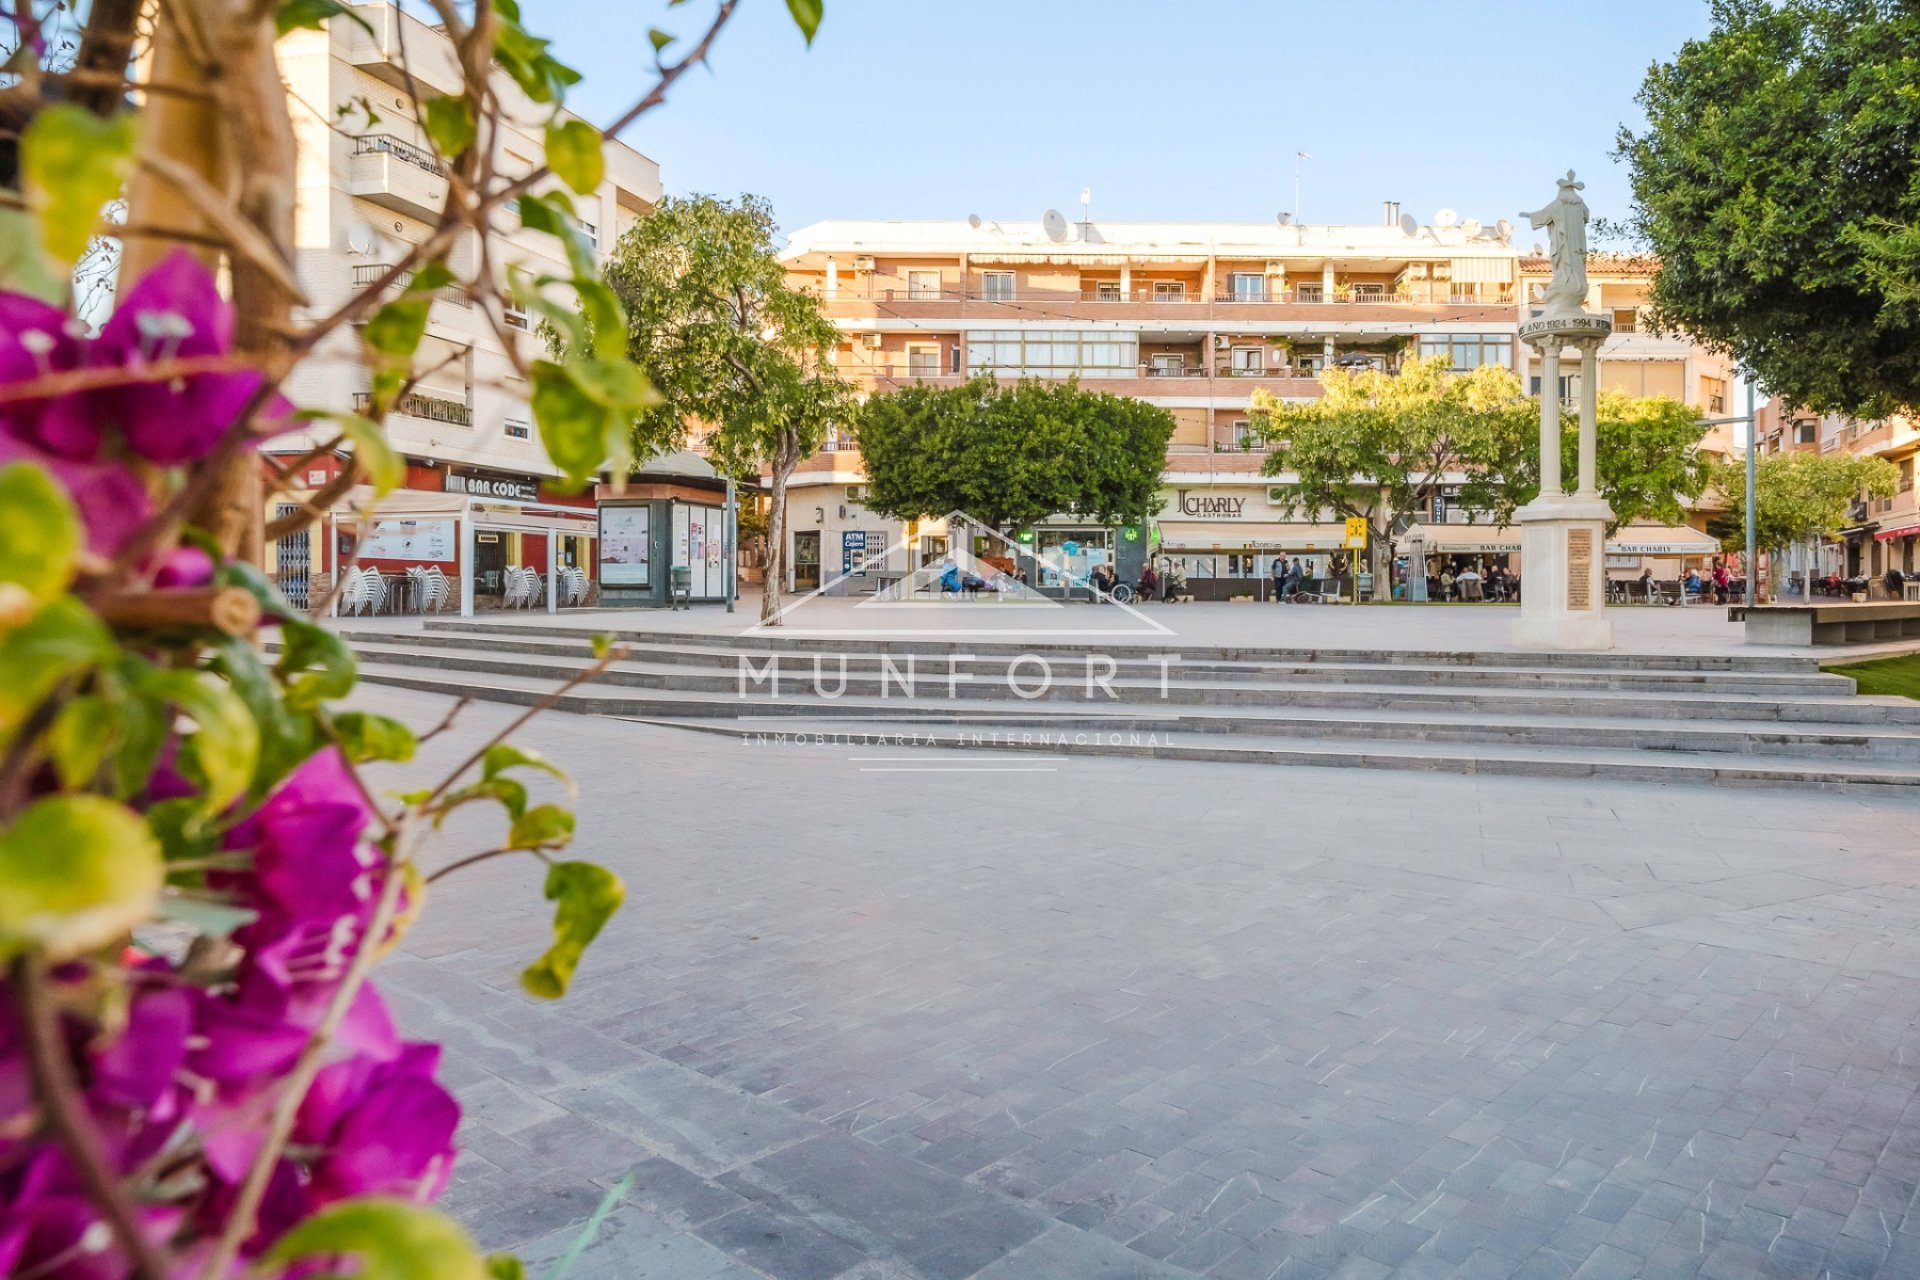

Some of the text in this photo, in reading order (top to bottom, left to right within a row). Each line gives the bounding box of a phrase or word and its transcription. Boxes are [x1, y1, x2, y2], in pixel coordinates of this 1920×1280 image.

[468, 479, 491, 494] BAR
[492, 482, 521, 498] CODE
[845, 533, 864, 541] ATM
